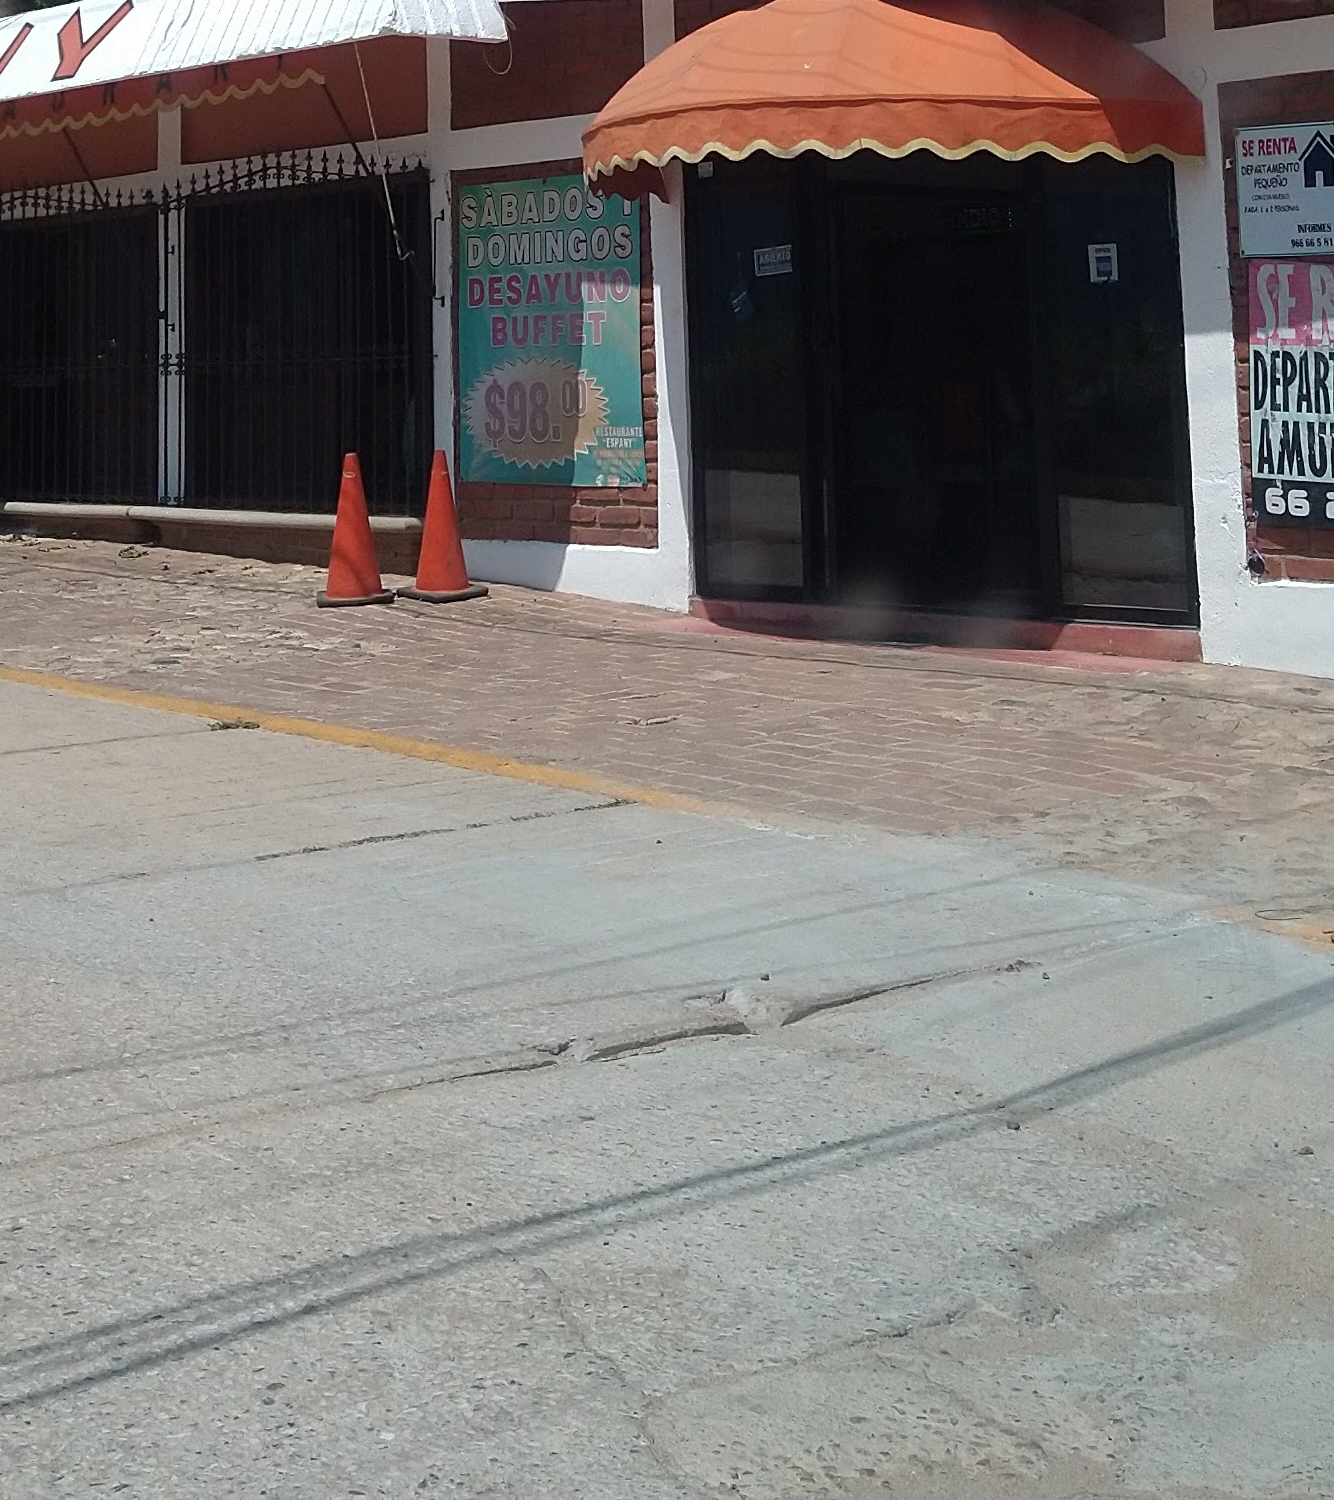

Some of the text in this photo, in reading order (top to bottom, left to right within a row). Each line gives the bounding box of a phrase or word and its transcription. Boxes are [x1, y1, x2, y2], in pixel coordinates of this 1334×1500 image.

[1241, 137, 1298, 157] SE RENTA
[1241, 162, 1300, 176] DEPARTAMENTO
[467, 223, 633, 269] DOMINGOS
[468, 266, 631, 308] DESAYUNO
[1256, 263, 1296, 340] SE
[490, 311, 607, 348] BUFFET
[1265, 487, 1310, 516] 66
